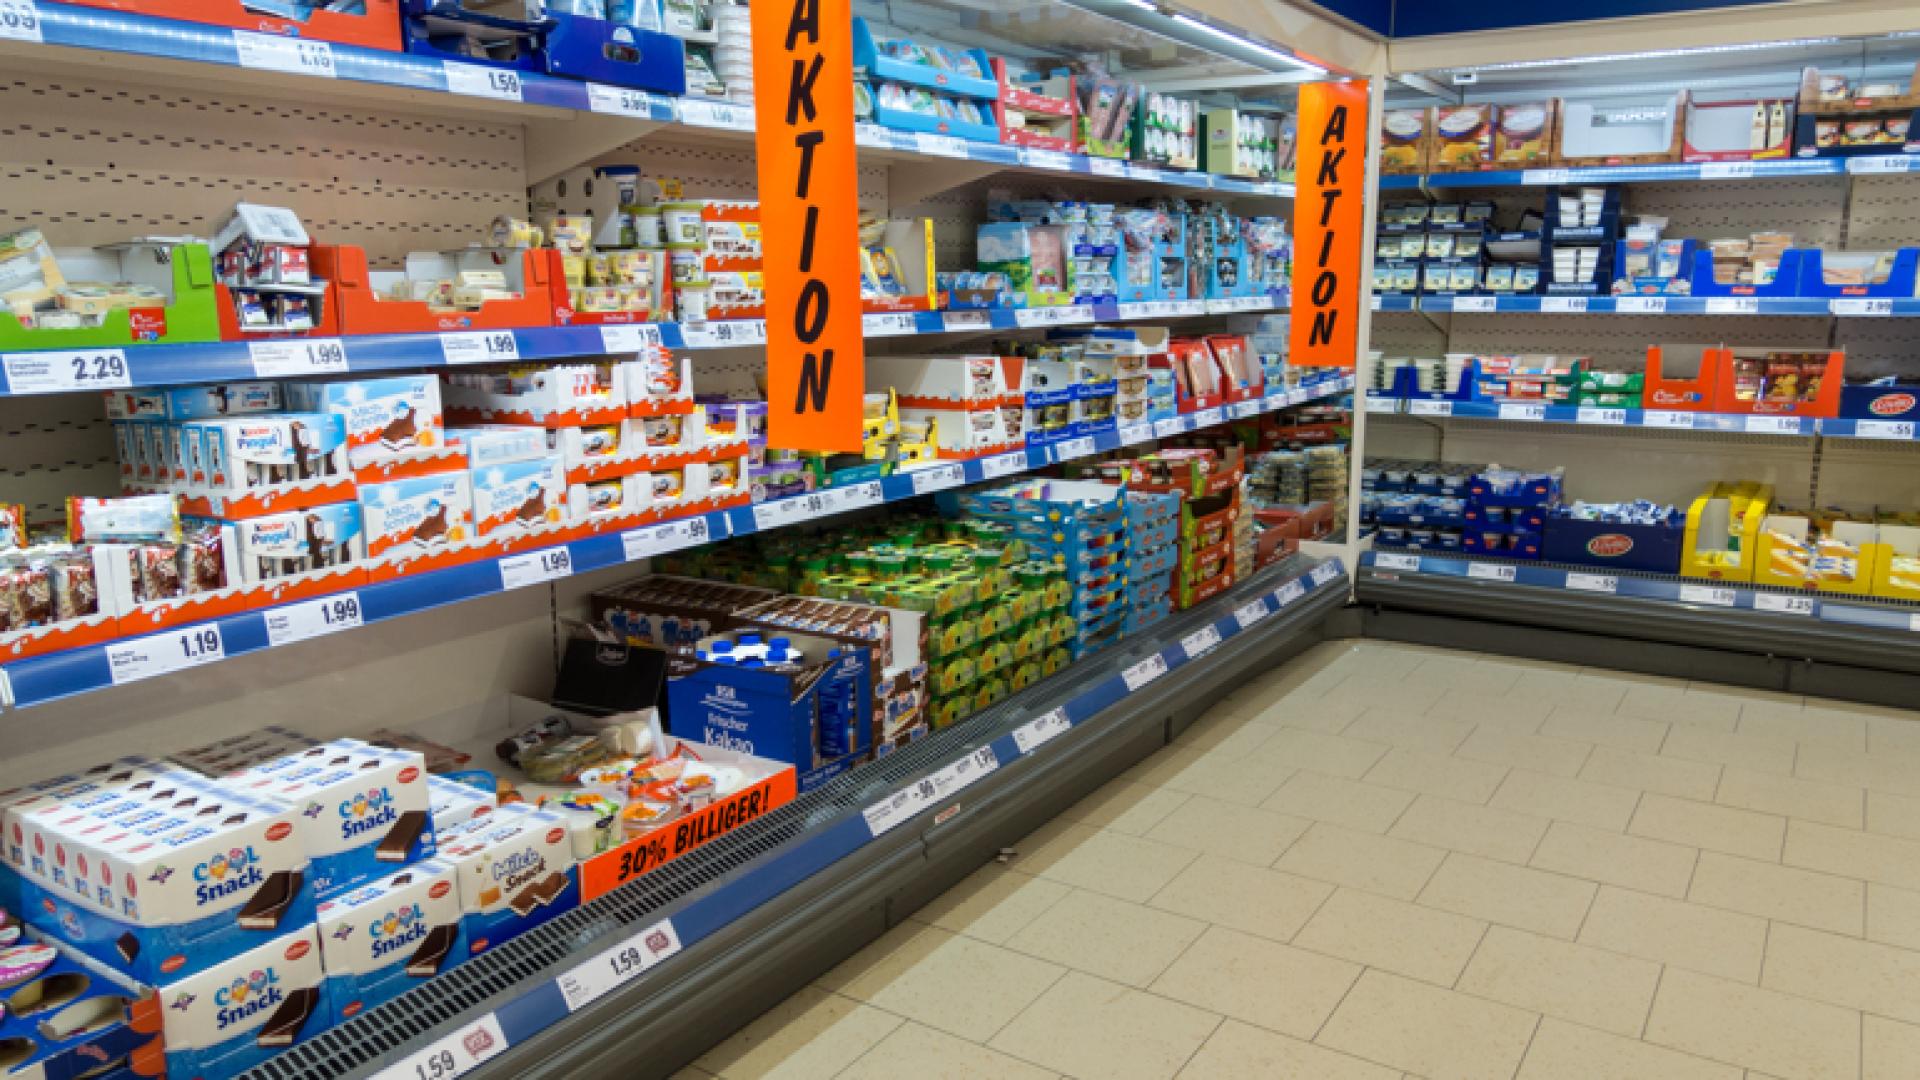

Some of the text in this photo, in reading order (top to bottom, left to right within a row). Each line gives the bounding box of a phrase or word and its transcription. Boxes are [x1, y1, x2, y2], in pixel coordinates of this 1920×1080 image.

[785, 0, 834, 414] AKTION
[1308, 104, 1347, 347] AKTION
[71, 355, 124, 381] 2.29
[306, 344, 342, 365] 1.99
[322, 598, 357, 625] 1.99
[180, 628, 218, 657] 1.19
[338, 787, 394, 819] COOL
[341, 805, 397, 839] Snack
[618, 784, 771, 881] 30% BILLIGER!
[192, 845, 261, 881] COOL
[195, 865, 263, 906] Snack
[368, 902, 425, 938] COOL
[371, 922, 427, 958] Snack
[610, 947, 642, 976] 1.59
[214, 967, 280, 1006] COOL
[216, 987, 283, 1030] Snack
